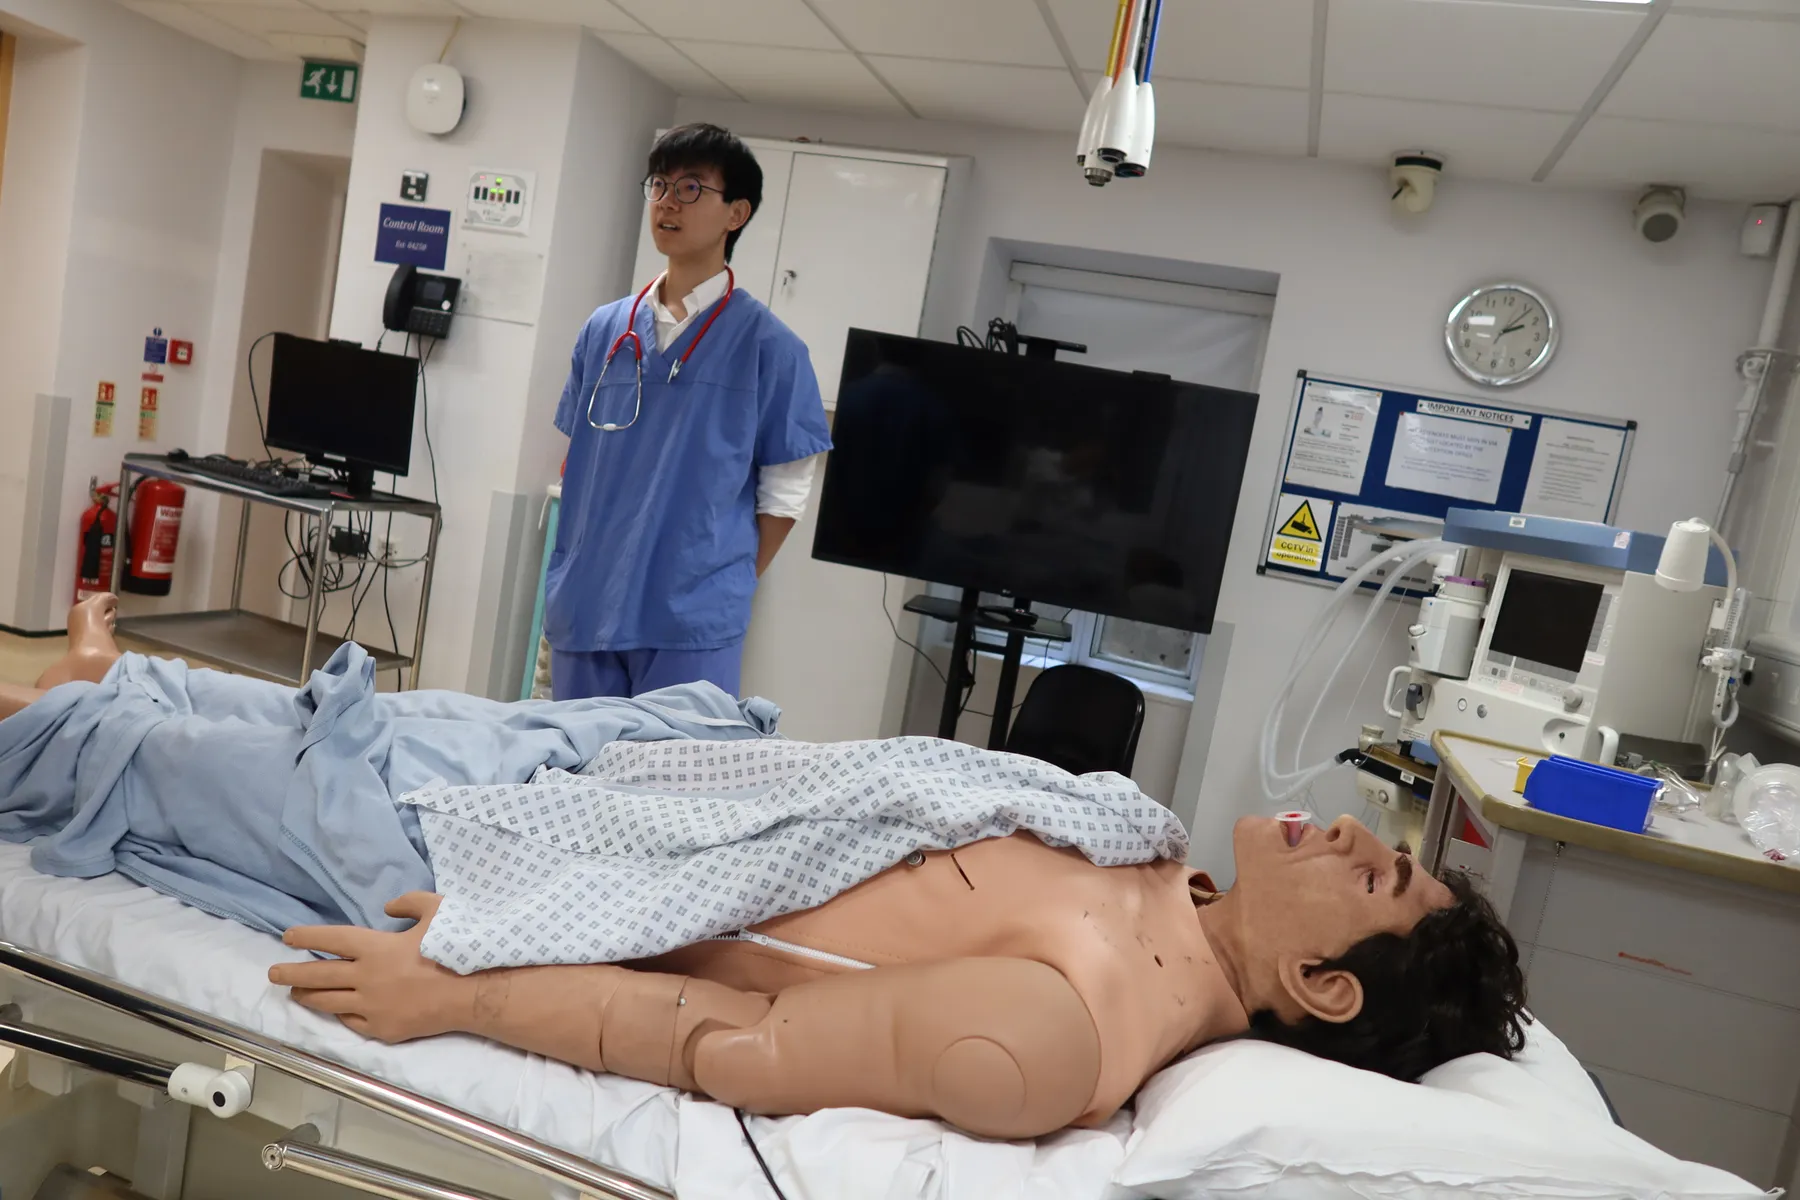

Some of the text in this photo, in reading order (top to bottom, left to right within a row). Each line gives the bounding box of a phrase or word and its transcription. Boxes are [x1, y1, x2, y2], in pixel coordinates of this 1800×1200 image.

[383, 217, 445, 234] Control Room
[1485, 296, 1497, 308] 11
[1503, 296, 1515, 307] 12
[1523, 303, 1528, 312] 1
[1532, 316, 1540, 327] 2
[1463, 322, 1470, 332] 9
[1534, 332, 1541, 342] 3
[1464, 338, 1471, 349] 8
[1475, 351, 1482, 361] 7
[1524, 348, 1532, 358] 4
[1490, 359, 1498, 369] 6
[1509, 358, 1516, 368] 5
[1427, 402, 1515, 424] IMPORTANT NOTICES
[1281, 541, 1314, 553] CCTV in
